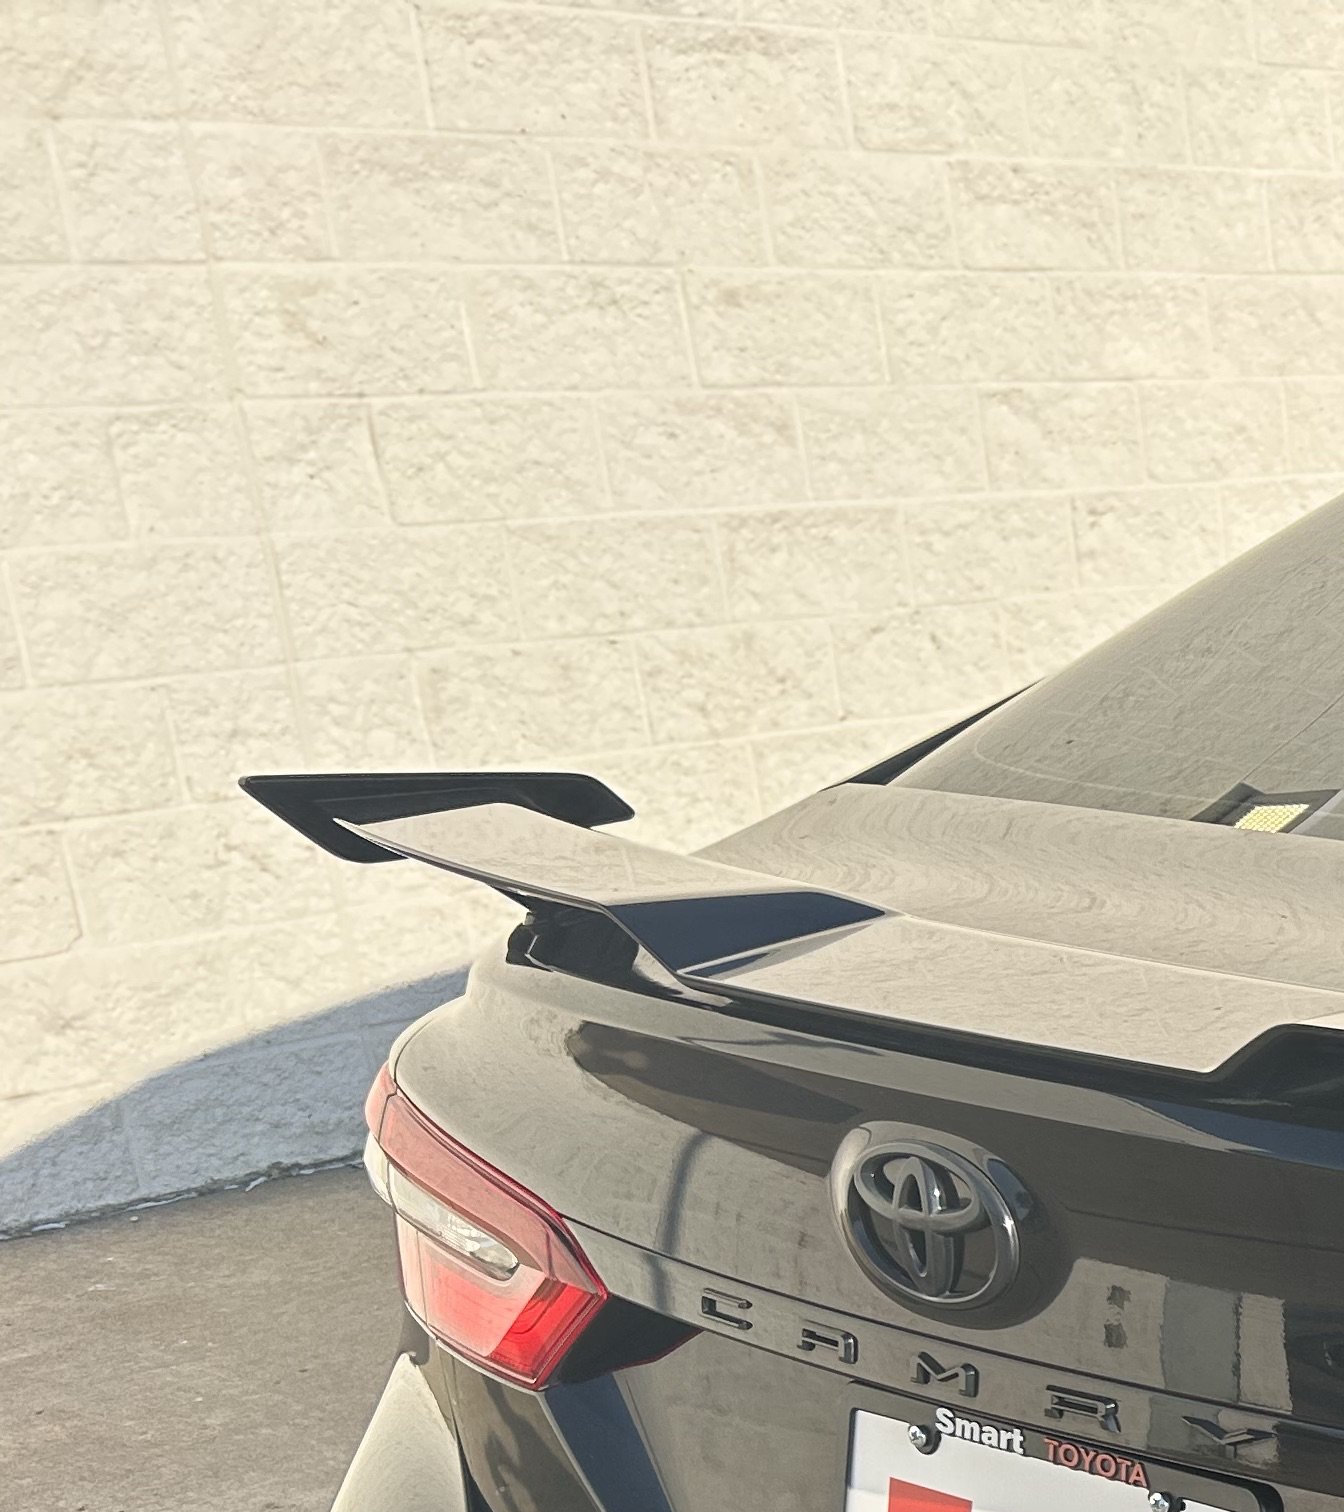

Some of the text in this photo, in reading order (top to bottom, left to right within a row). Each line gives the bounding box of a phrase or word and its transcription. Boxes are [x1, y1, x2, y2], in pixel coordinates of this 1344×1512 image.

[699, 1287, 1270, 1451] CAMRY
[935, 1407, 1149, 1488] Smart TOYOTA
